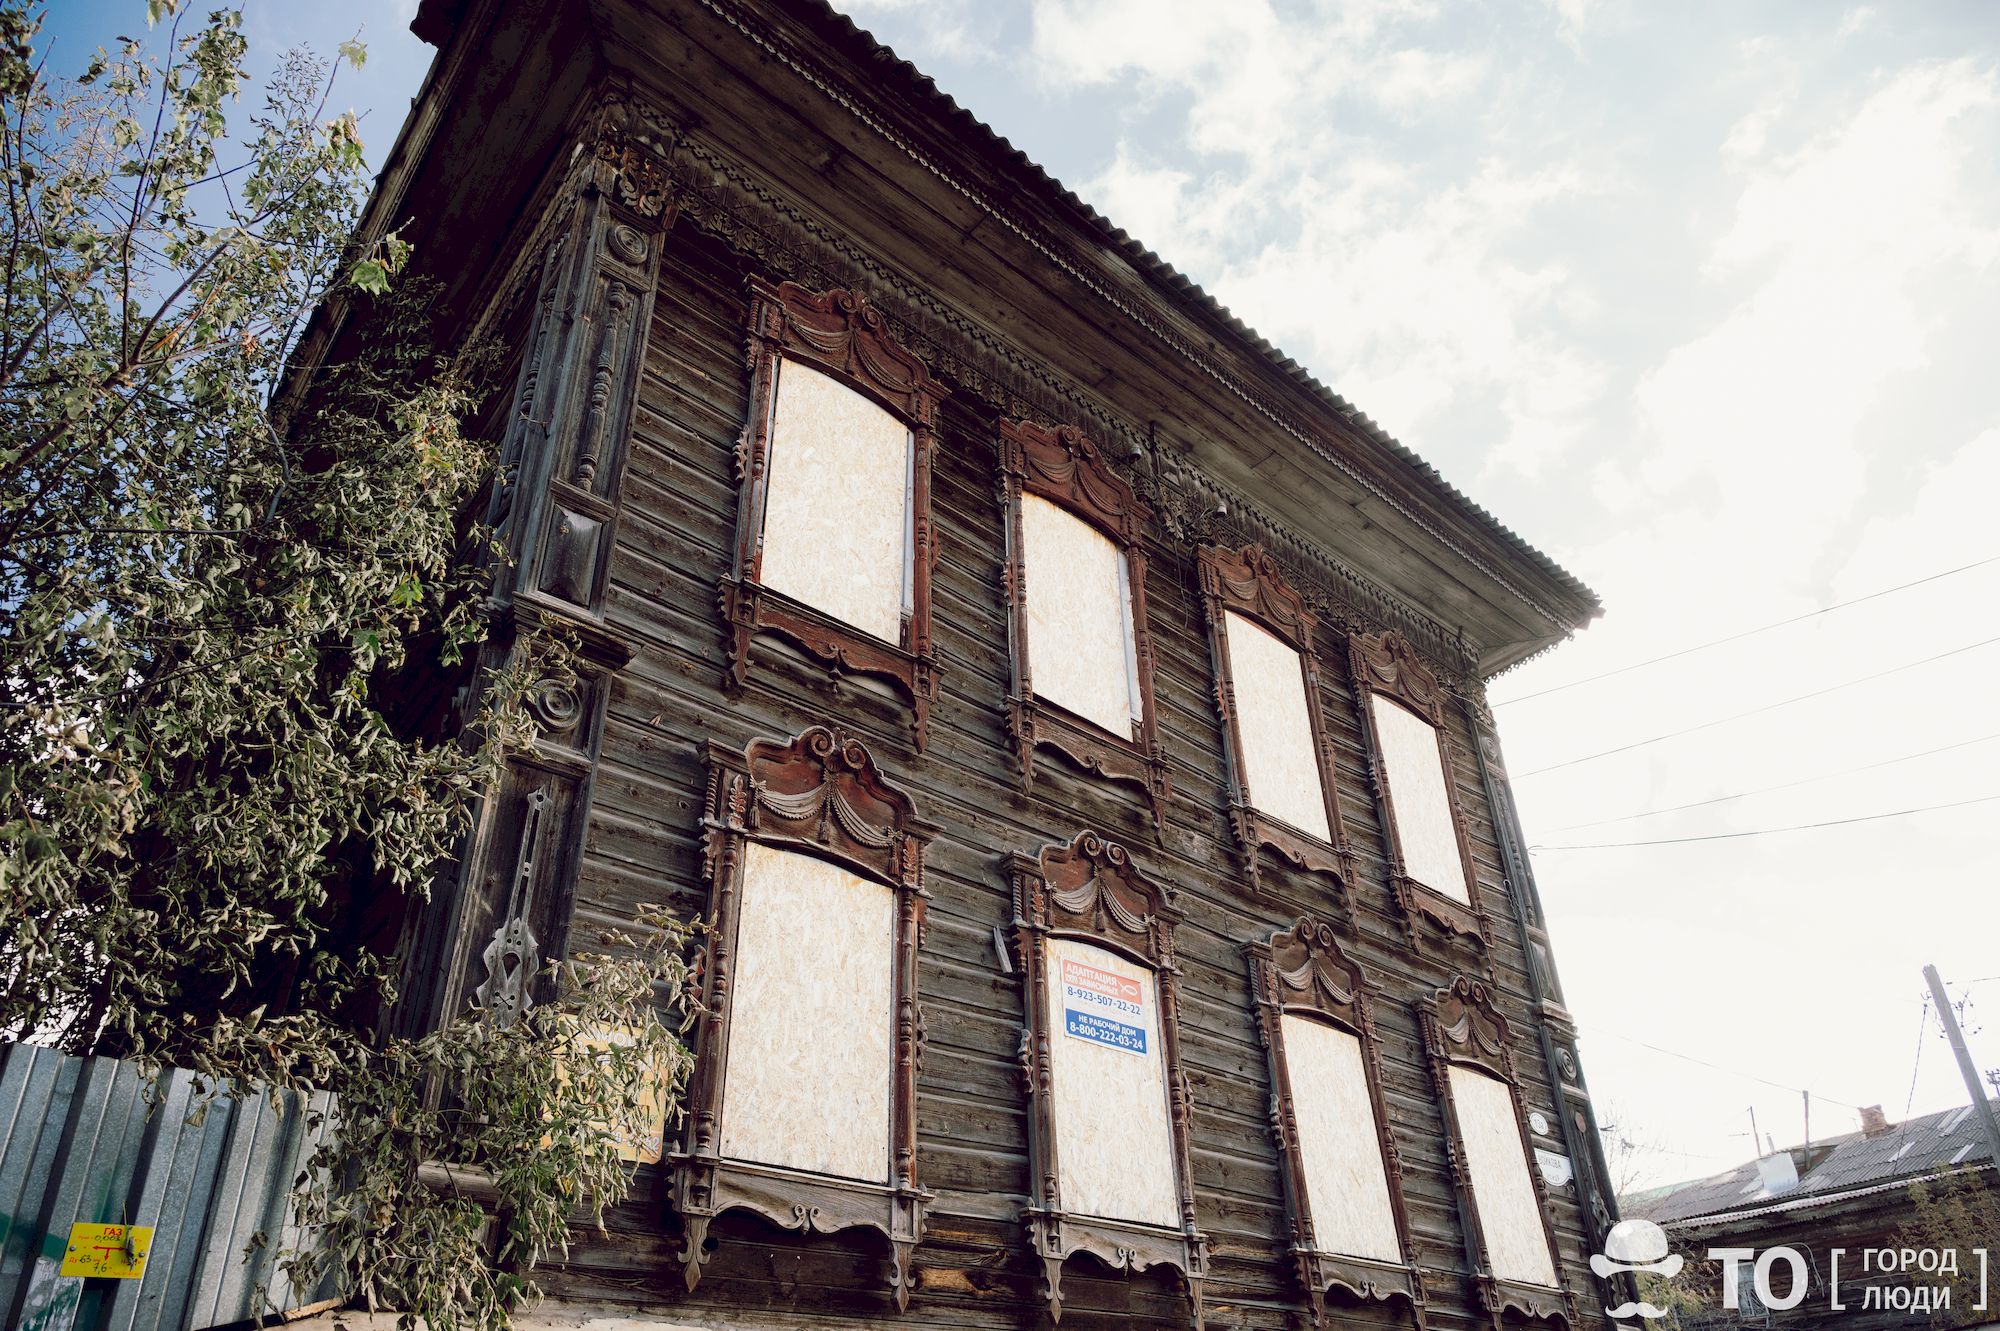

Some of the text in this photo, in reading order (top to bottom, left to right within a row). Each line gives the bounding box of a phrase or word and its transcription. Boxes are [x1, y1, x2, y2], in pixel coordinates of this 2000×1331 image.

[1066, 963, 1117, 987] АДАПТАЦИЯ
[1067, 986, 1141, 1015] 8-923-507-22-22
[1069, 1022, 1143, 1050] 8-800-222-03-24
[1078, 1014, 1136, 1037] НЕ РАБОЧИЙ ДОМ
[103, 1227, 122, 1236] ГАЗ
